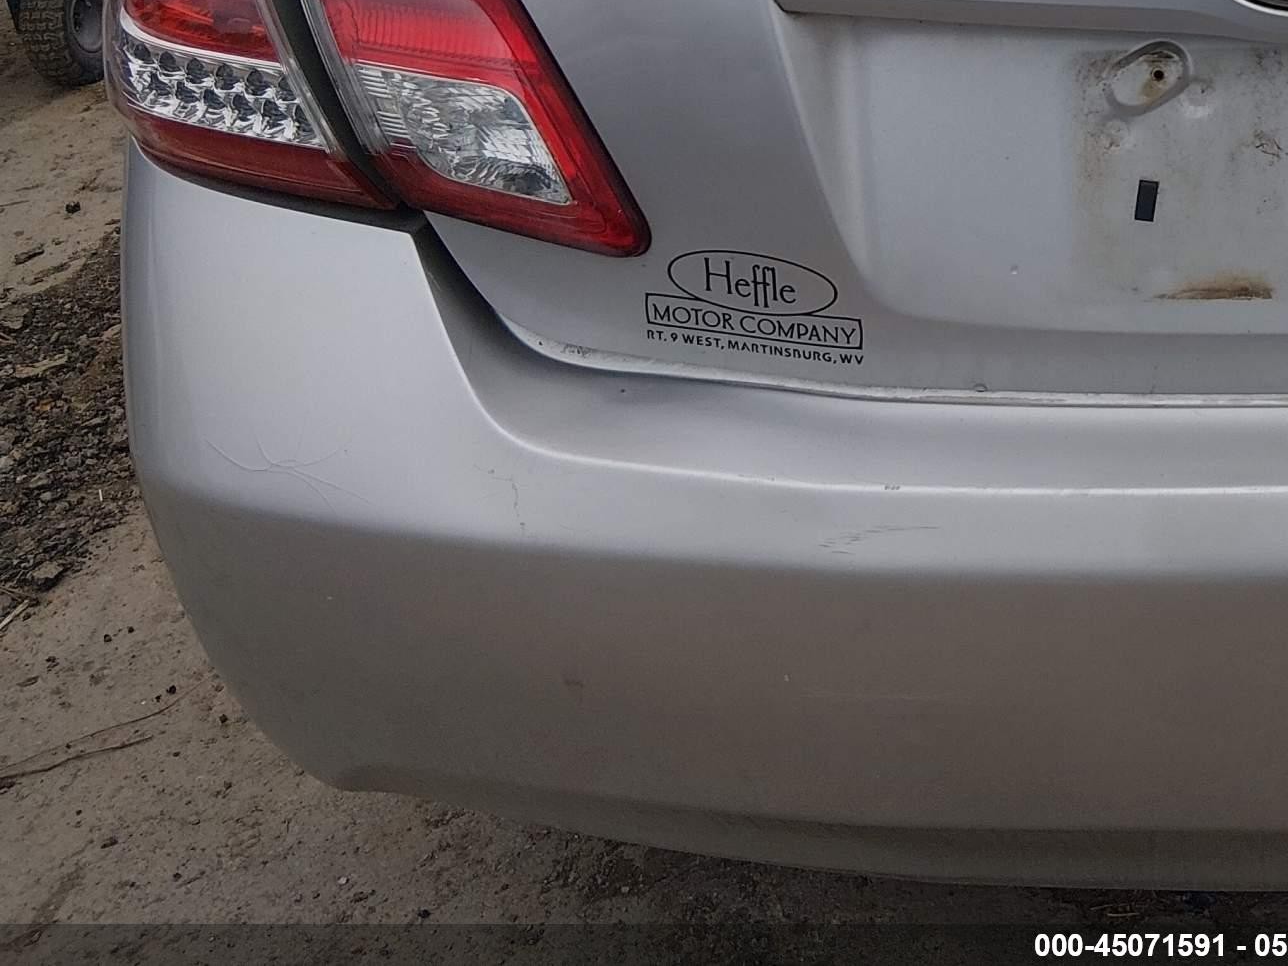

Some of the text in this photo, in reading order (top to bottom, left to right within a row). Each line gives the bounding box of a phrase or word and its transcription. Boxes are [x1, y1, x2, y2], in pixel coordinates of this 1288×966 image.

[704, 257, 796, 308] Heffle
[652, 303, 856, 345] MOTOR COMPANY
[647, 330, 864, 365] RT. 9 WEST, MARTINSBURG, WV
